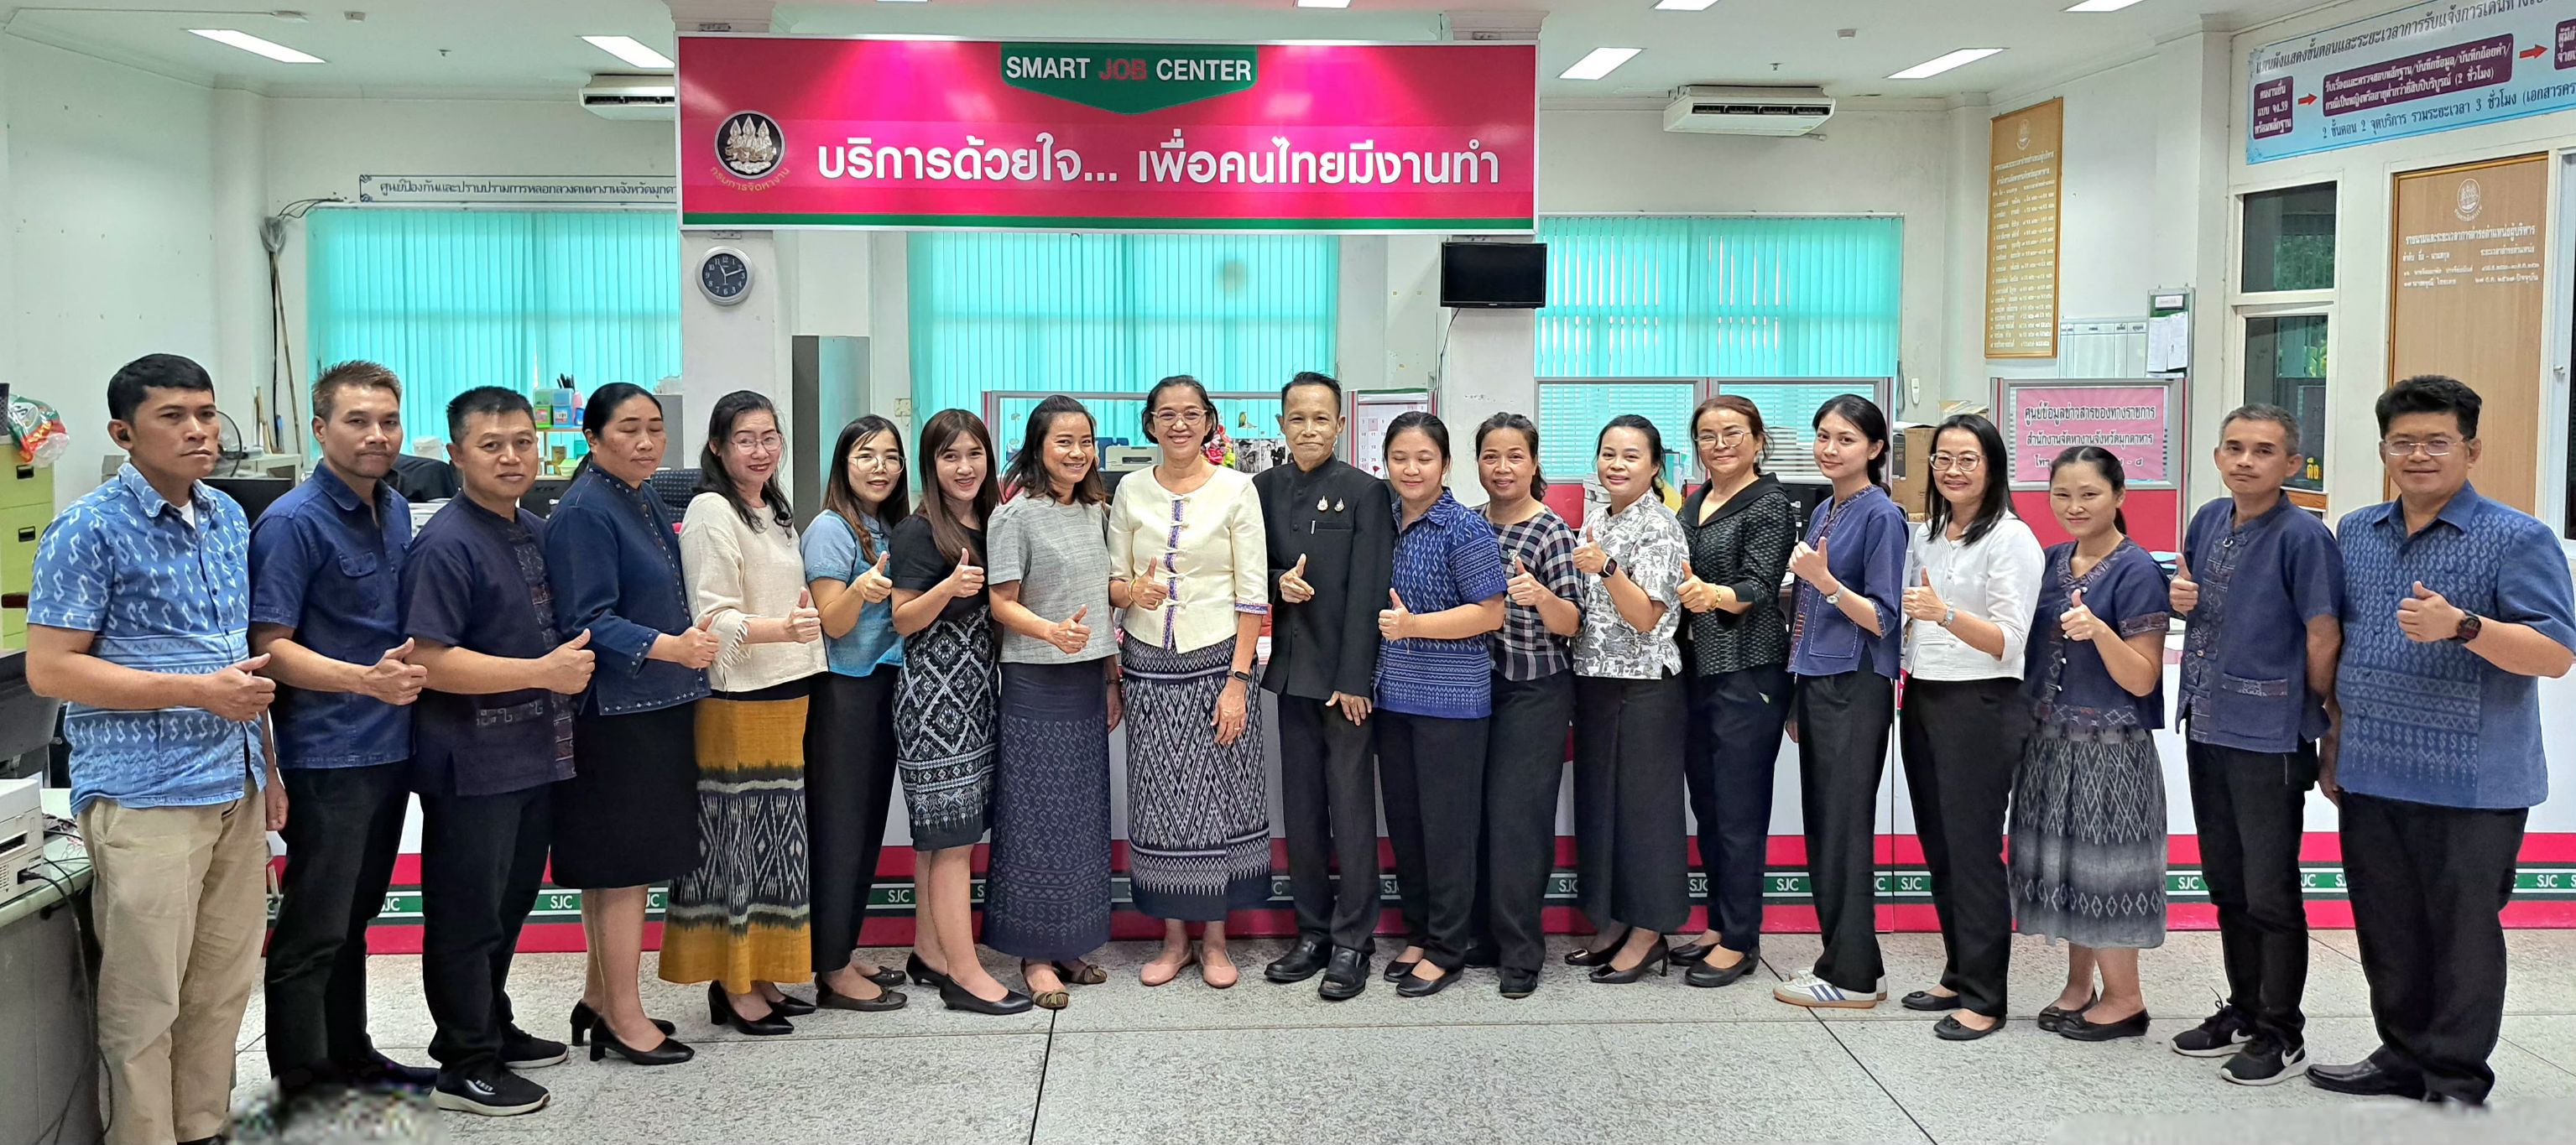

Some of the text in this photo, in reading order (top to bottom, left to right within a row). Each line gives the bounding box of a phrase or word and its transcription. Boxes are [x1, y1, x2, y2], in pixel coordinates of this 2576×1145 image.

[1006, 56, 1251, 81] SMART JOB CENTER
[2467, 65, 2494, 82] ชั่วโมง)
[2361, 119, 2366, 132] 2
[2370, 112, 2407, 135] จุดบริการ
[2412, 101, 2470, 122] รวมระยะเวลา
[2476, 98, 2481, 112] 3
[2488, 88, 2516, 109] ชั่วโมง
[818, 128, 1499, 185] บริการด้วยใจ... เพื่อคนไทยมีงานทำ
[711, 167, 790, 191] กรมการจัดหางาน
[2025, 401, 2156, 425] ศูนย์ข้อมูลข่าวสารของทางราชการ
[2026, 431, 2153, 449] สำนักงานจัดหางานจังหวัดมุกดาหาร
[1384, 881, 1400, 893] SJ
[1776, 877, 1799, 891] SJC
[1901, 877, 1922, 890] SJC
[2178, 877, 2199, 890] SJC
[2300, 874, 2315, 887] JC
[2334, 874, 2346, 887] SJ
[2536, 874, 2558, 887] SJC
[550, 894, 573, 909] SJC
[645, 893, 660, 907] JC
[888, 889, 910, 903] SJC
